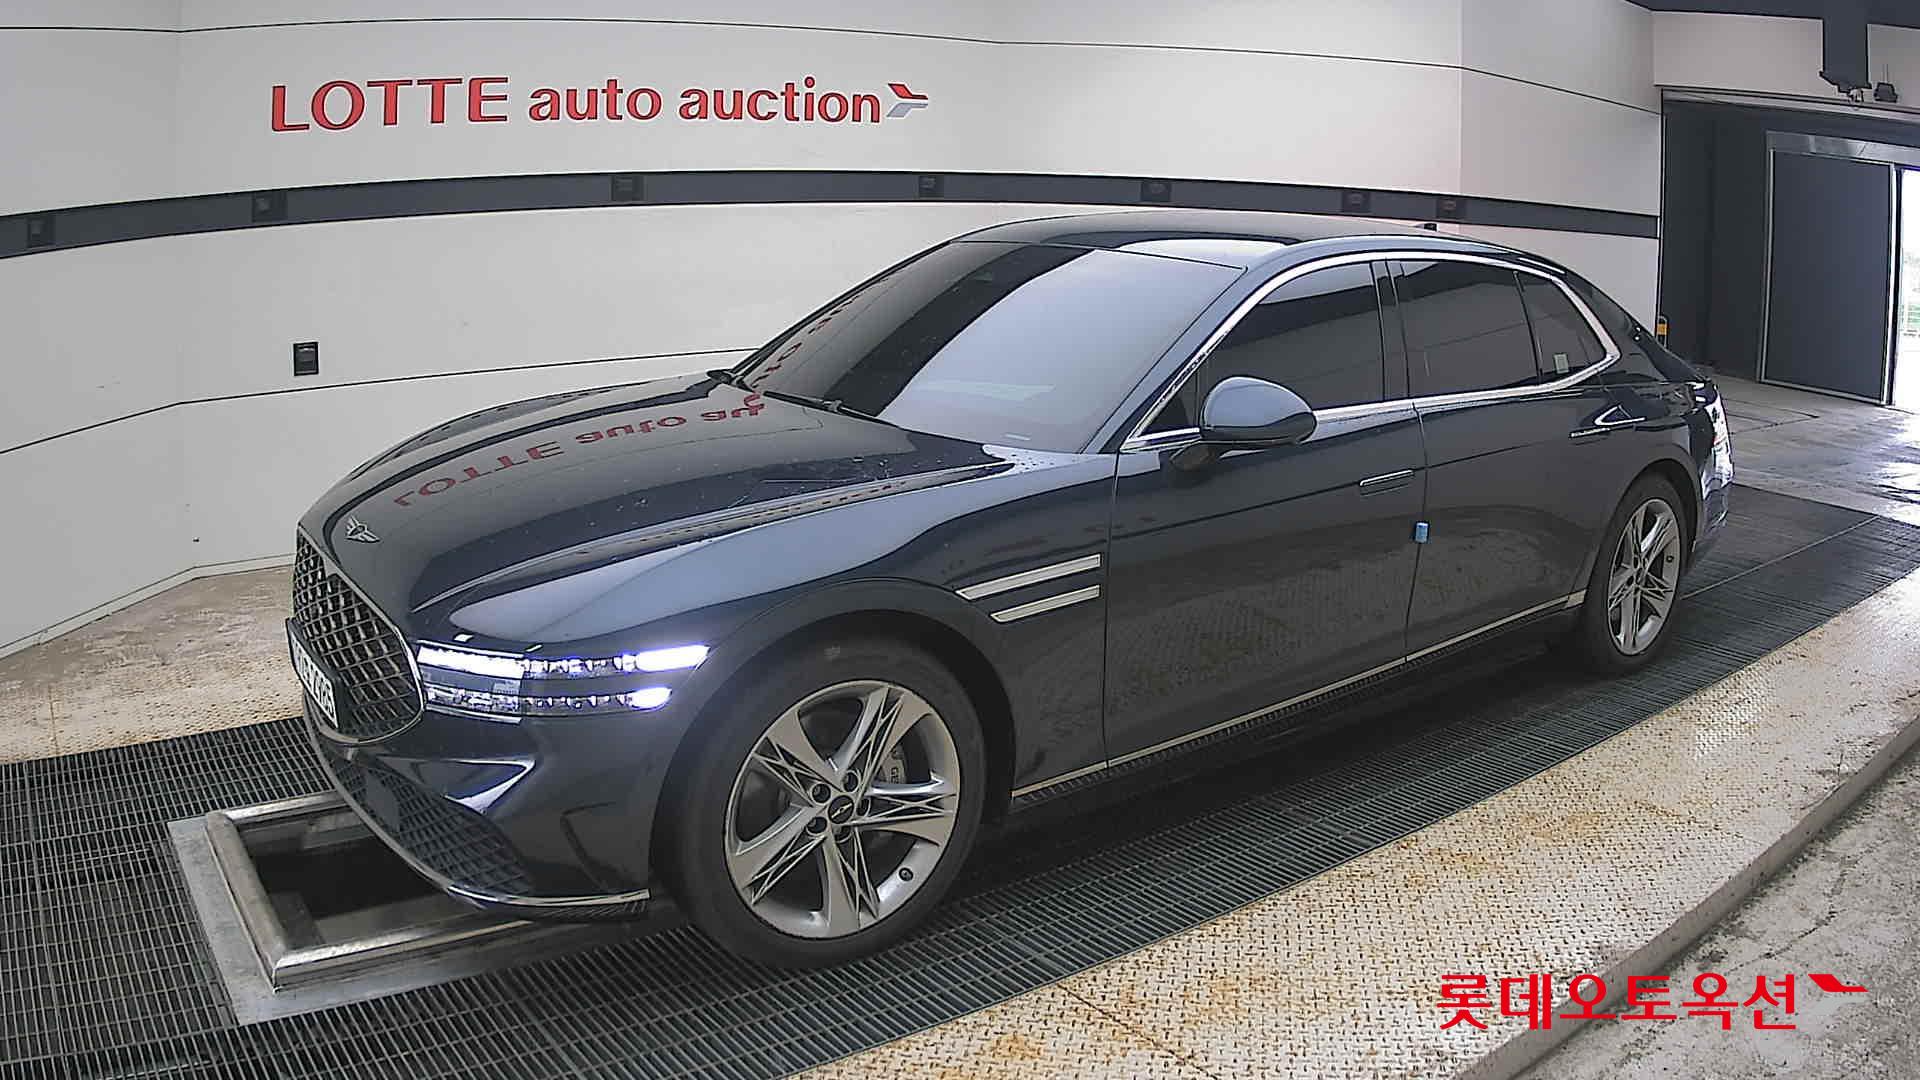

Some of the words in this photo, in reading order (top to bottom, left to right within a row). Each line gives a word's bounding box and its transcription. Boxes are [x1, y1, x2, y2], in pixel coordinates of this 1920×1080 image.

[271, 76, 508, 133] LOTTE
[528, 78, 663, 122] auto
[678, 76, 882, 123] auction
